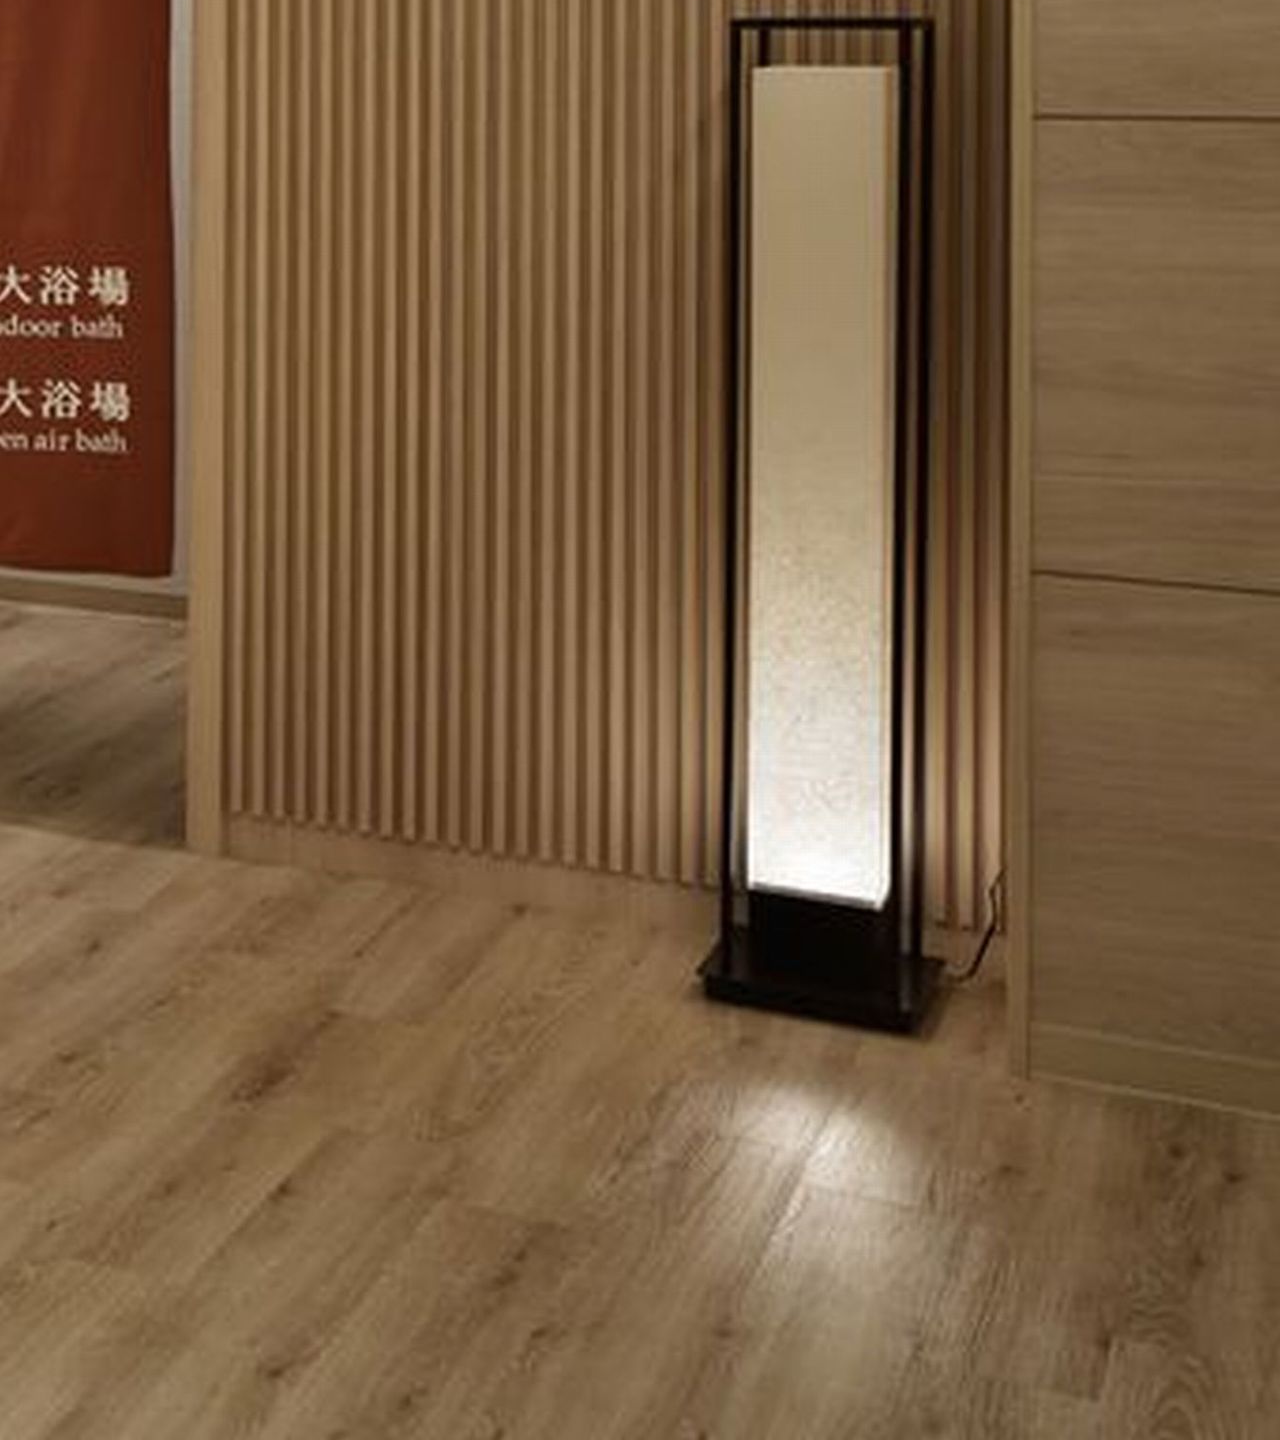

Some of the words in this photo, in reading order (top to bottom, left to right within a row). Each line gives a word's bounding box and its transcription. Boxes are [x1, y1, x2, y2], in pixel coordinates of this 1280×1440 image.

[70, 313, 124, 339] bath
[33, 429, 71, 452] air
[75, 428, 128, 453] bath
